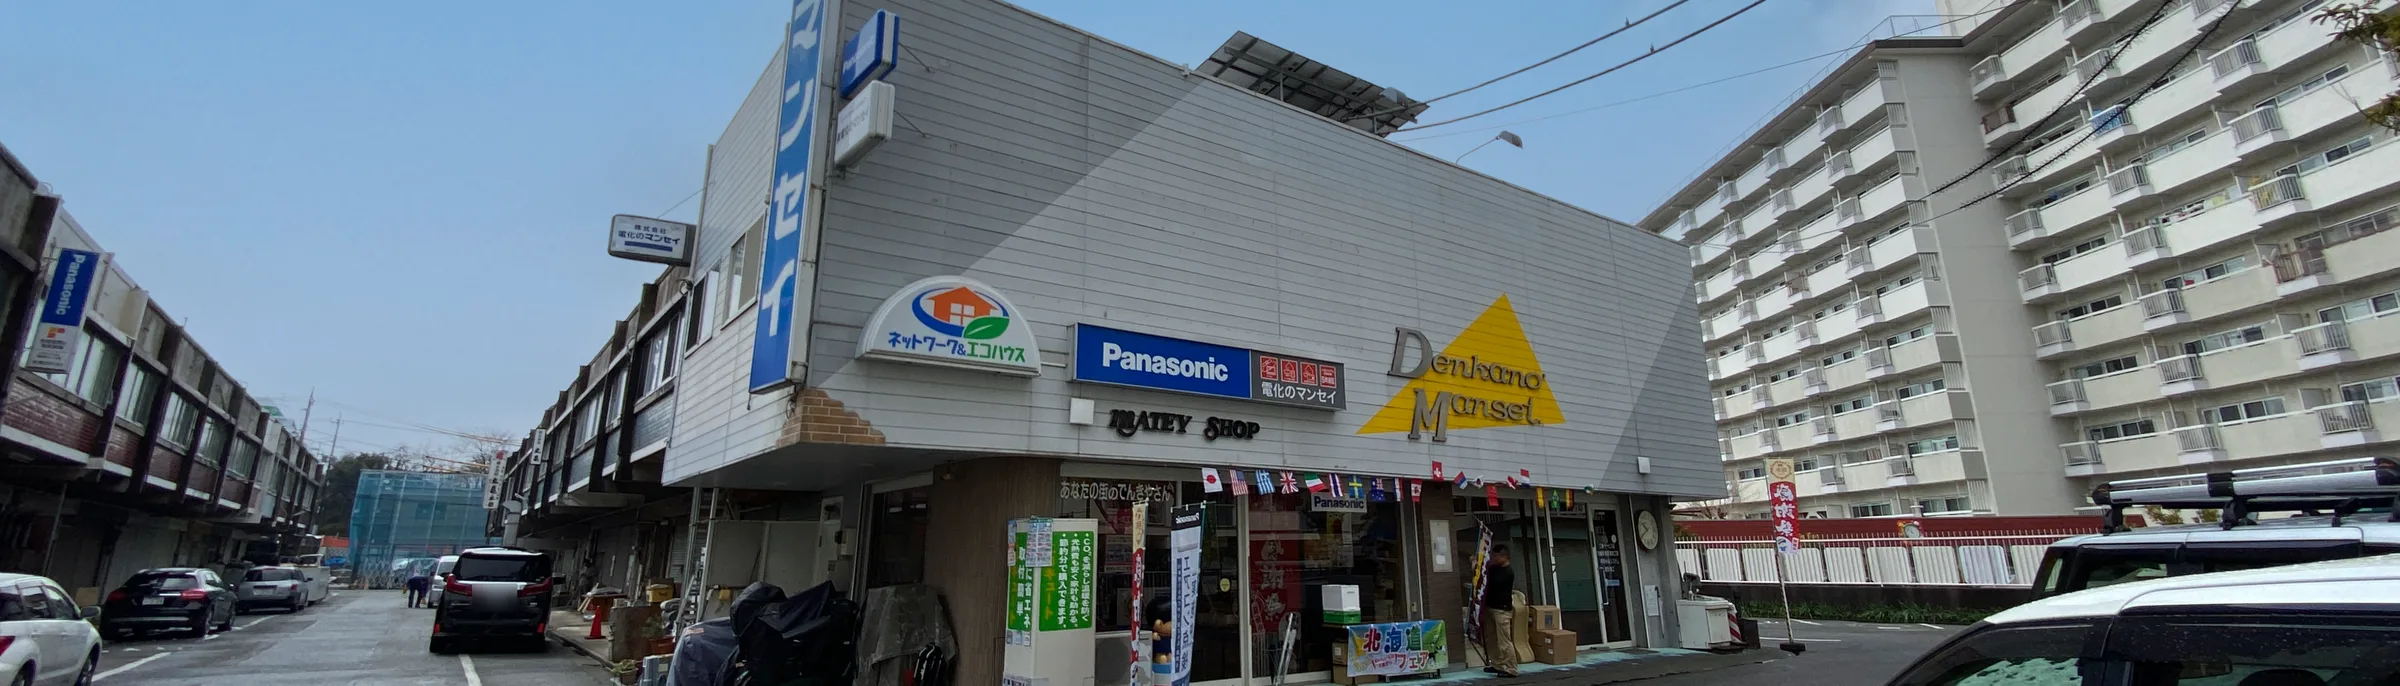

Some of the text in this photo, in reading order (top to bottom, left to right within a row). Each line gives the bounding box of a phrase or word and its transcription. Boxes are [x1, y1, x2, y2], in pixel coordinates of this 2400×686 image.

[618, 230, 681, 245] 電化のマンセイ
[634, 224, 667, 234] 株式会社
[55, 253, 87, 316] Panasonic
[1102, 341, 1229, 381] Panasonic
[1387, 326, 1544, 390] Denkano
[1261, 381, 1336, 404] 電化のマンセイ
[1108, 409, 1260, 440] MATEY SHOP
[1060, 481, 1171, 501] あなたの街のでんきやさん
[1313, 495, 1365, 509] Panasonic
[1363, 625, 1421, 653] 北海道
[1397, 651, 1429, 669] フェア
